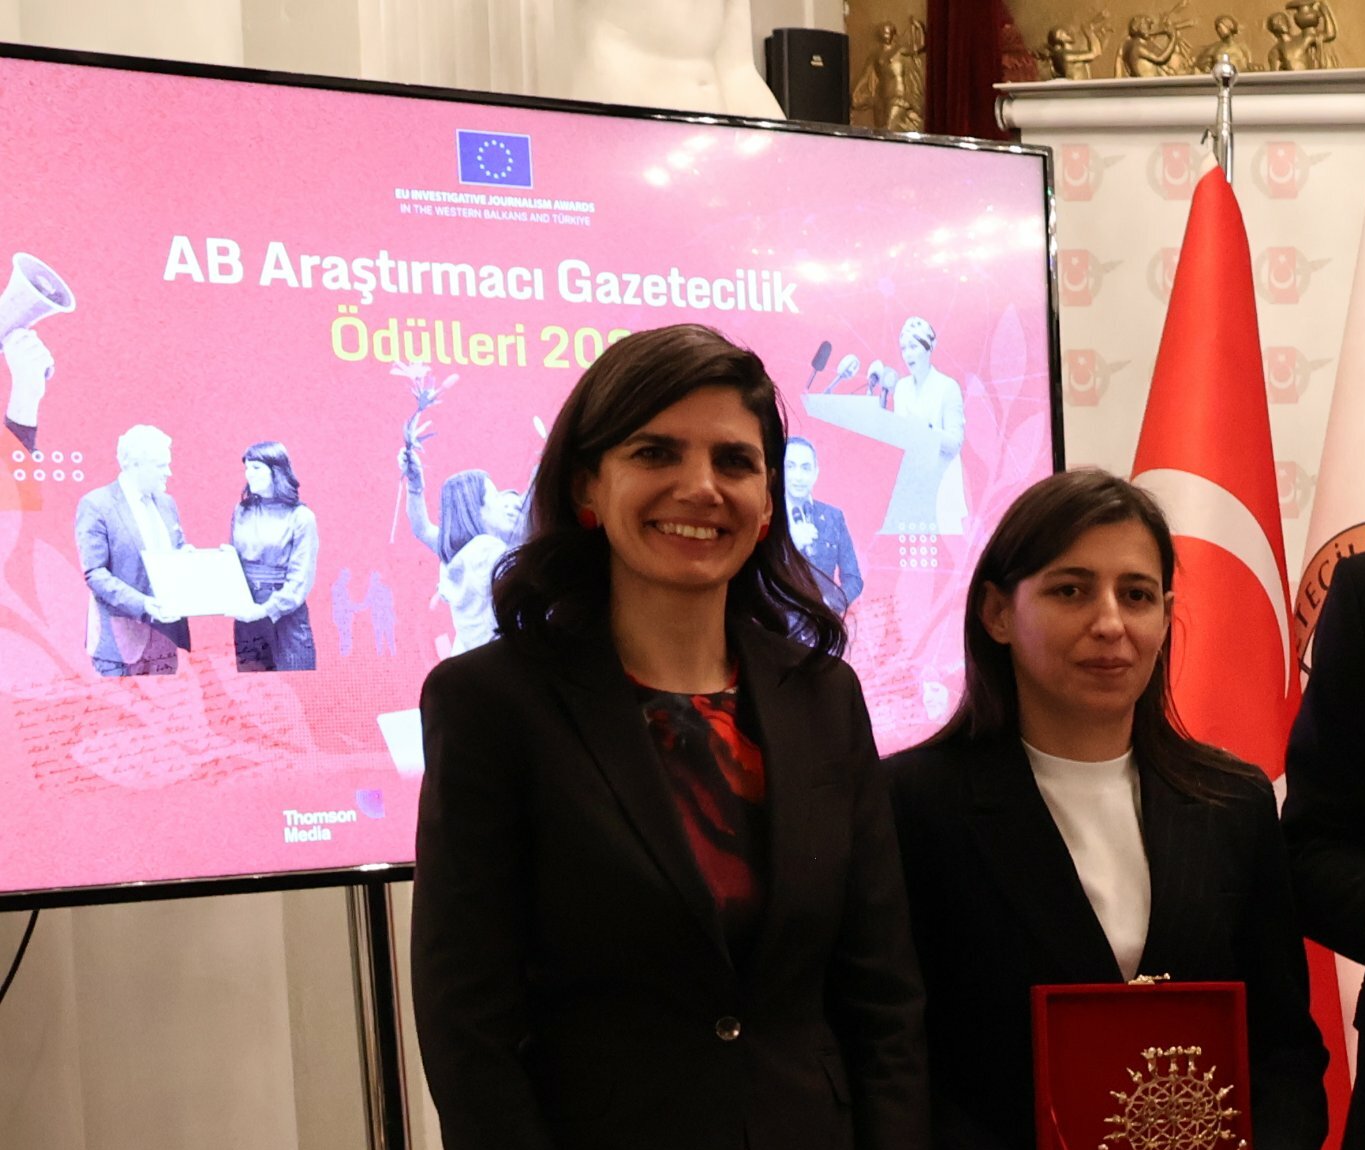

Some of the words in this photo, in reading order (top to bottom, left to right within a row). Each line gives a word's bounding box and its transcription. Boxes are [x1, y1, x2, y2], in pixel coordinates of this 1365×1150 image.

[395, 188, 410, 200] EU
[411, 190, 487, 206] INVESTIGATIVE
[488, 195, 552, 210] JOURNALISM
[553, 200, 595, 213] AWARDS
[400, 203, 411, 214] IN
[414, 204, 432, 215] THE
[435, 205, 482, 218] WESTERN
[484, 209, 528, 222] BALKANS
[530, 212, 550, 224] AND
[163, 235, 244, 284] AB
[259, 241, 544, 305] Araştırmacı
[557, 258, 800, 314] Gazetecilik
[331, 304, 527, 367] Ödülleri
[540, 325, 631, 369] 20
[283, 810, 356, 826] Thomson
[283, 826, 332, 843] Media
